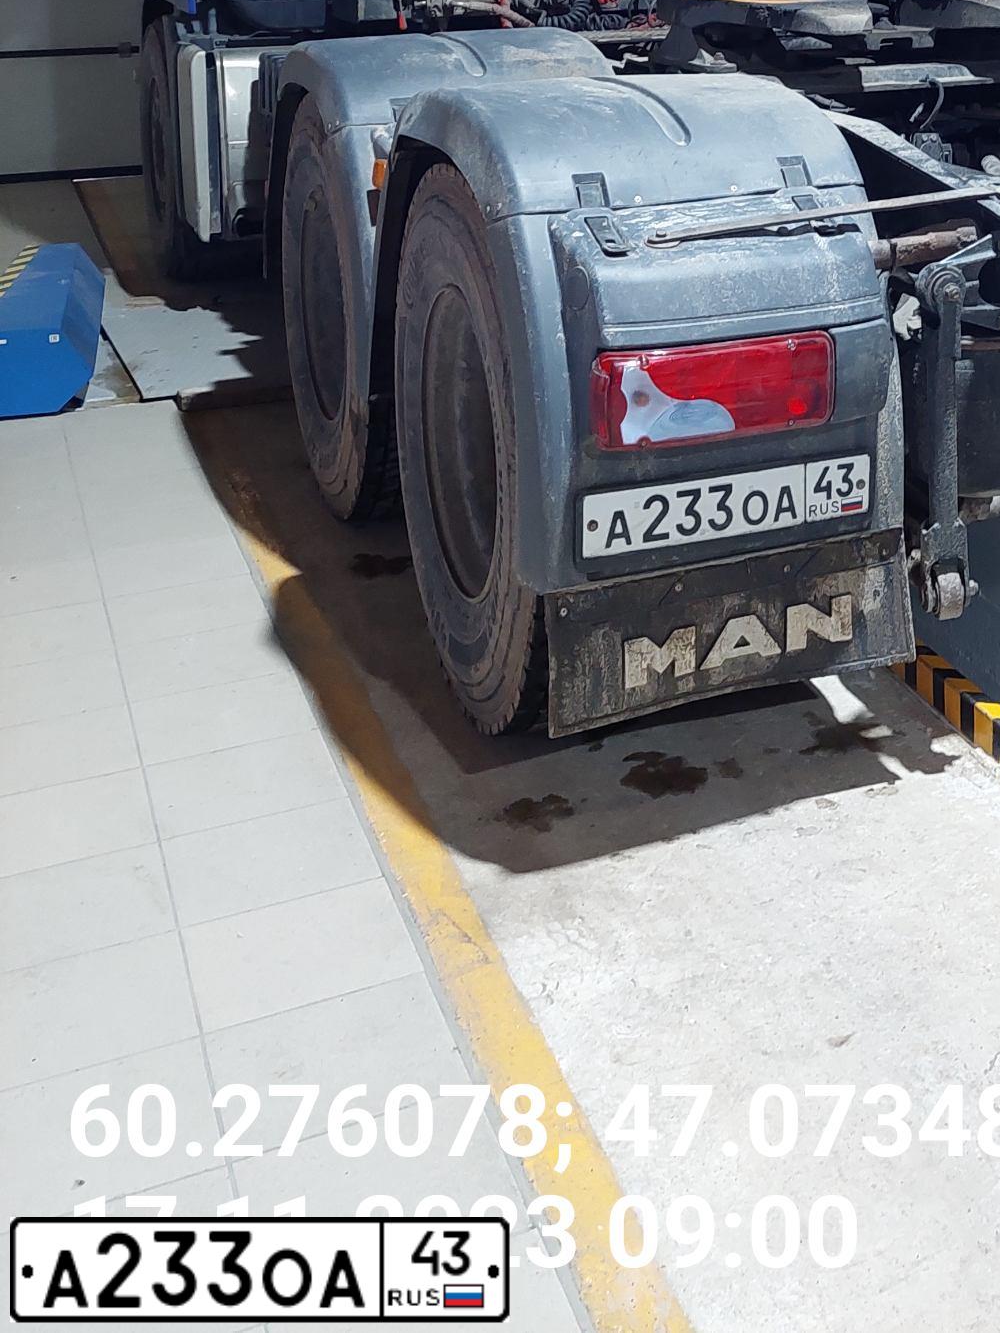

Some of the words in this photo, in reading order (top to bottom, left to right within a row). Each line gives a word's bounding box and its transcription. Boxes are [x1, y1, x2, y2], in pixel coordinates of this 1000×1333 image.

[813, 463, 855, 499] 43
[808, 500, 839, 517] RUS
[624, 594, 852, 689] MAN
